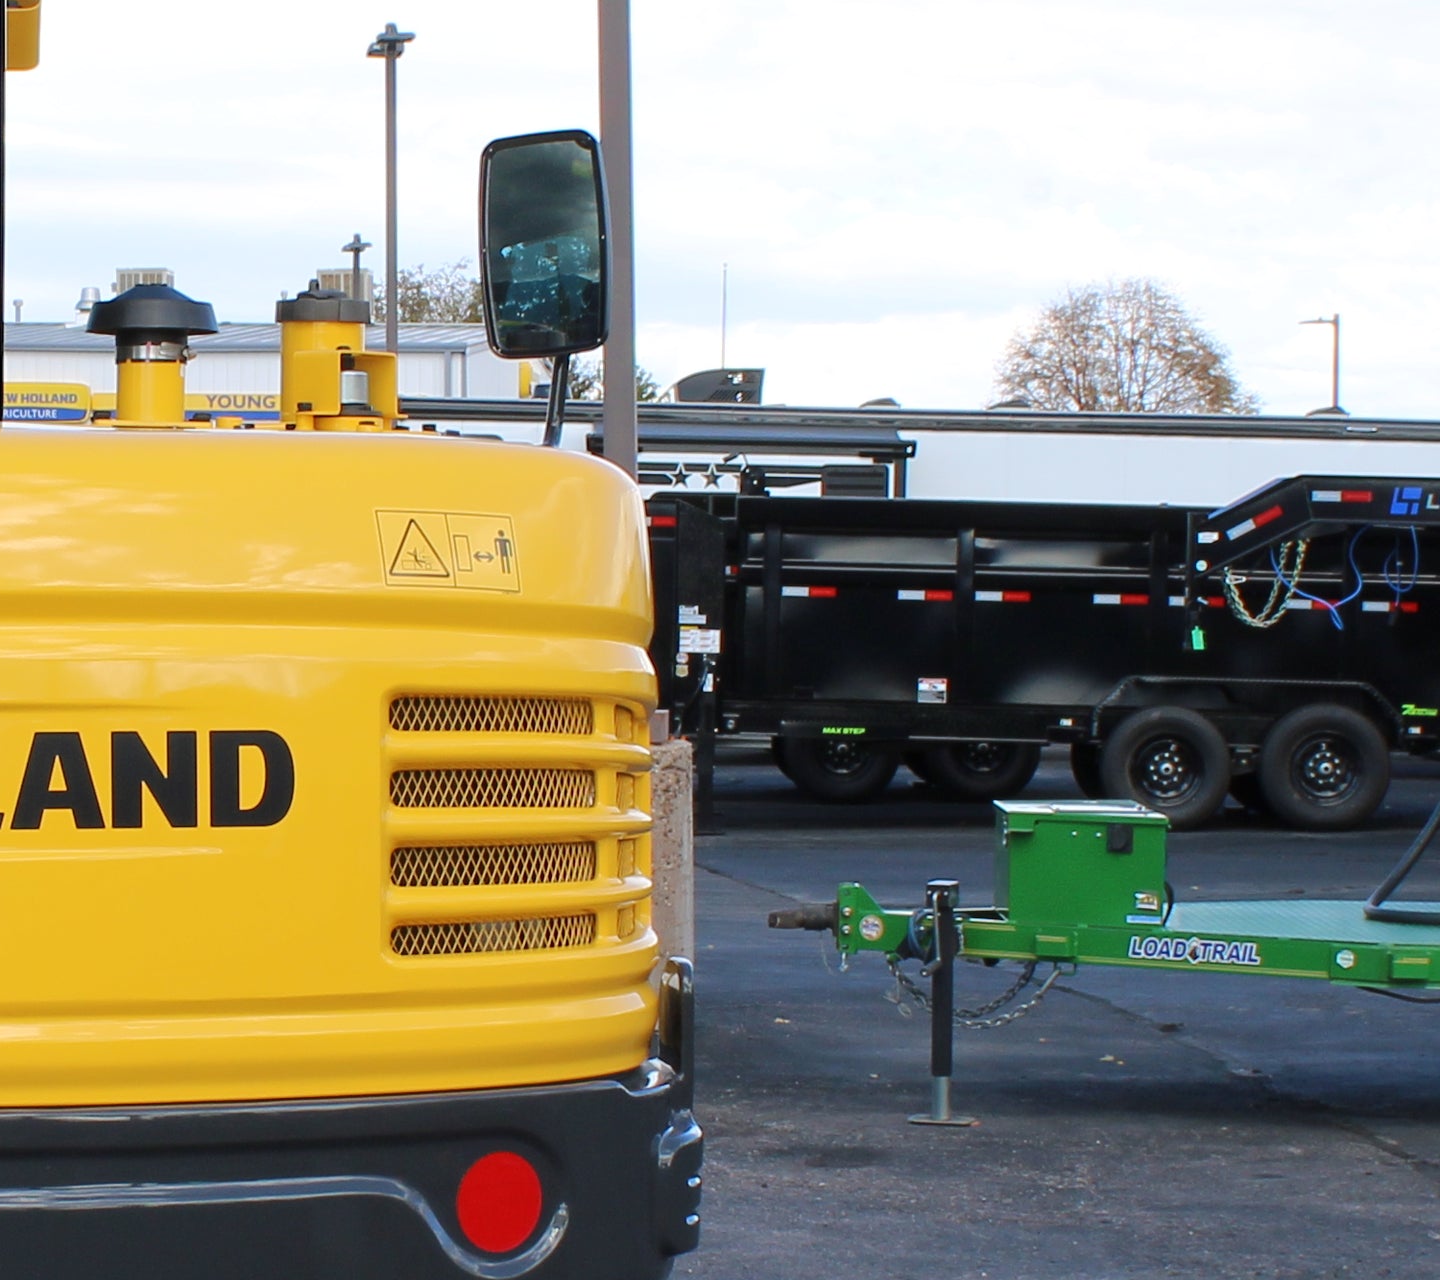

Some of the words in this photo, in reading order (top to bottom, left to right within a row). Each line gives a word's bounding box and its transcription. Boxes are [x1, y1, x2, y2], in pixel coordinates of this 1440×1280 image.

[21, 393, 78, 404] HOLLAND
[206, 394, 277, 409] YOUNG
[1129, 936, 1187, 959] LOAD
[1199, 941, 1262, 966] TRAIL
